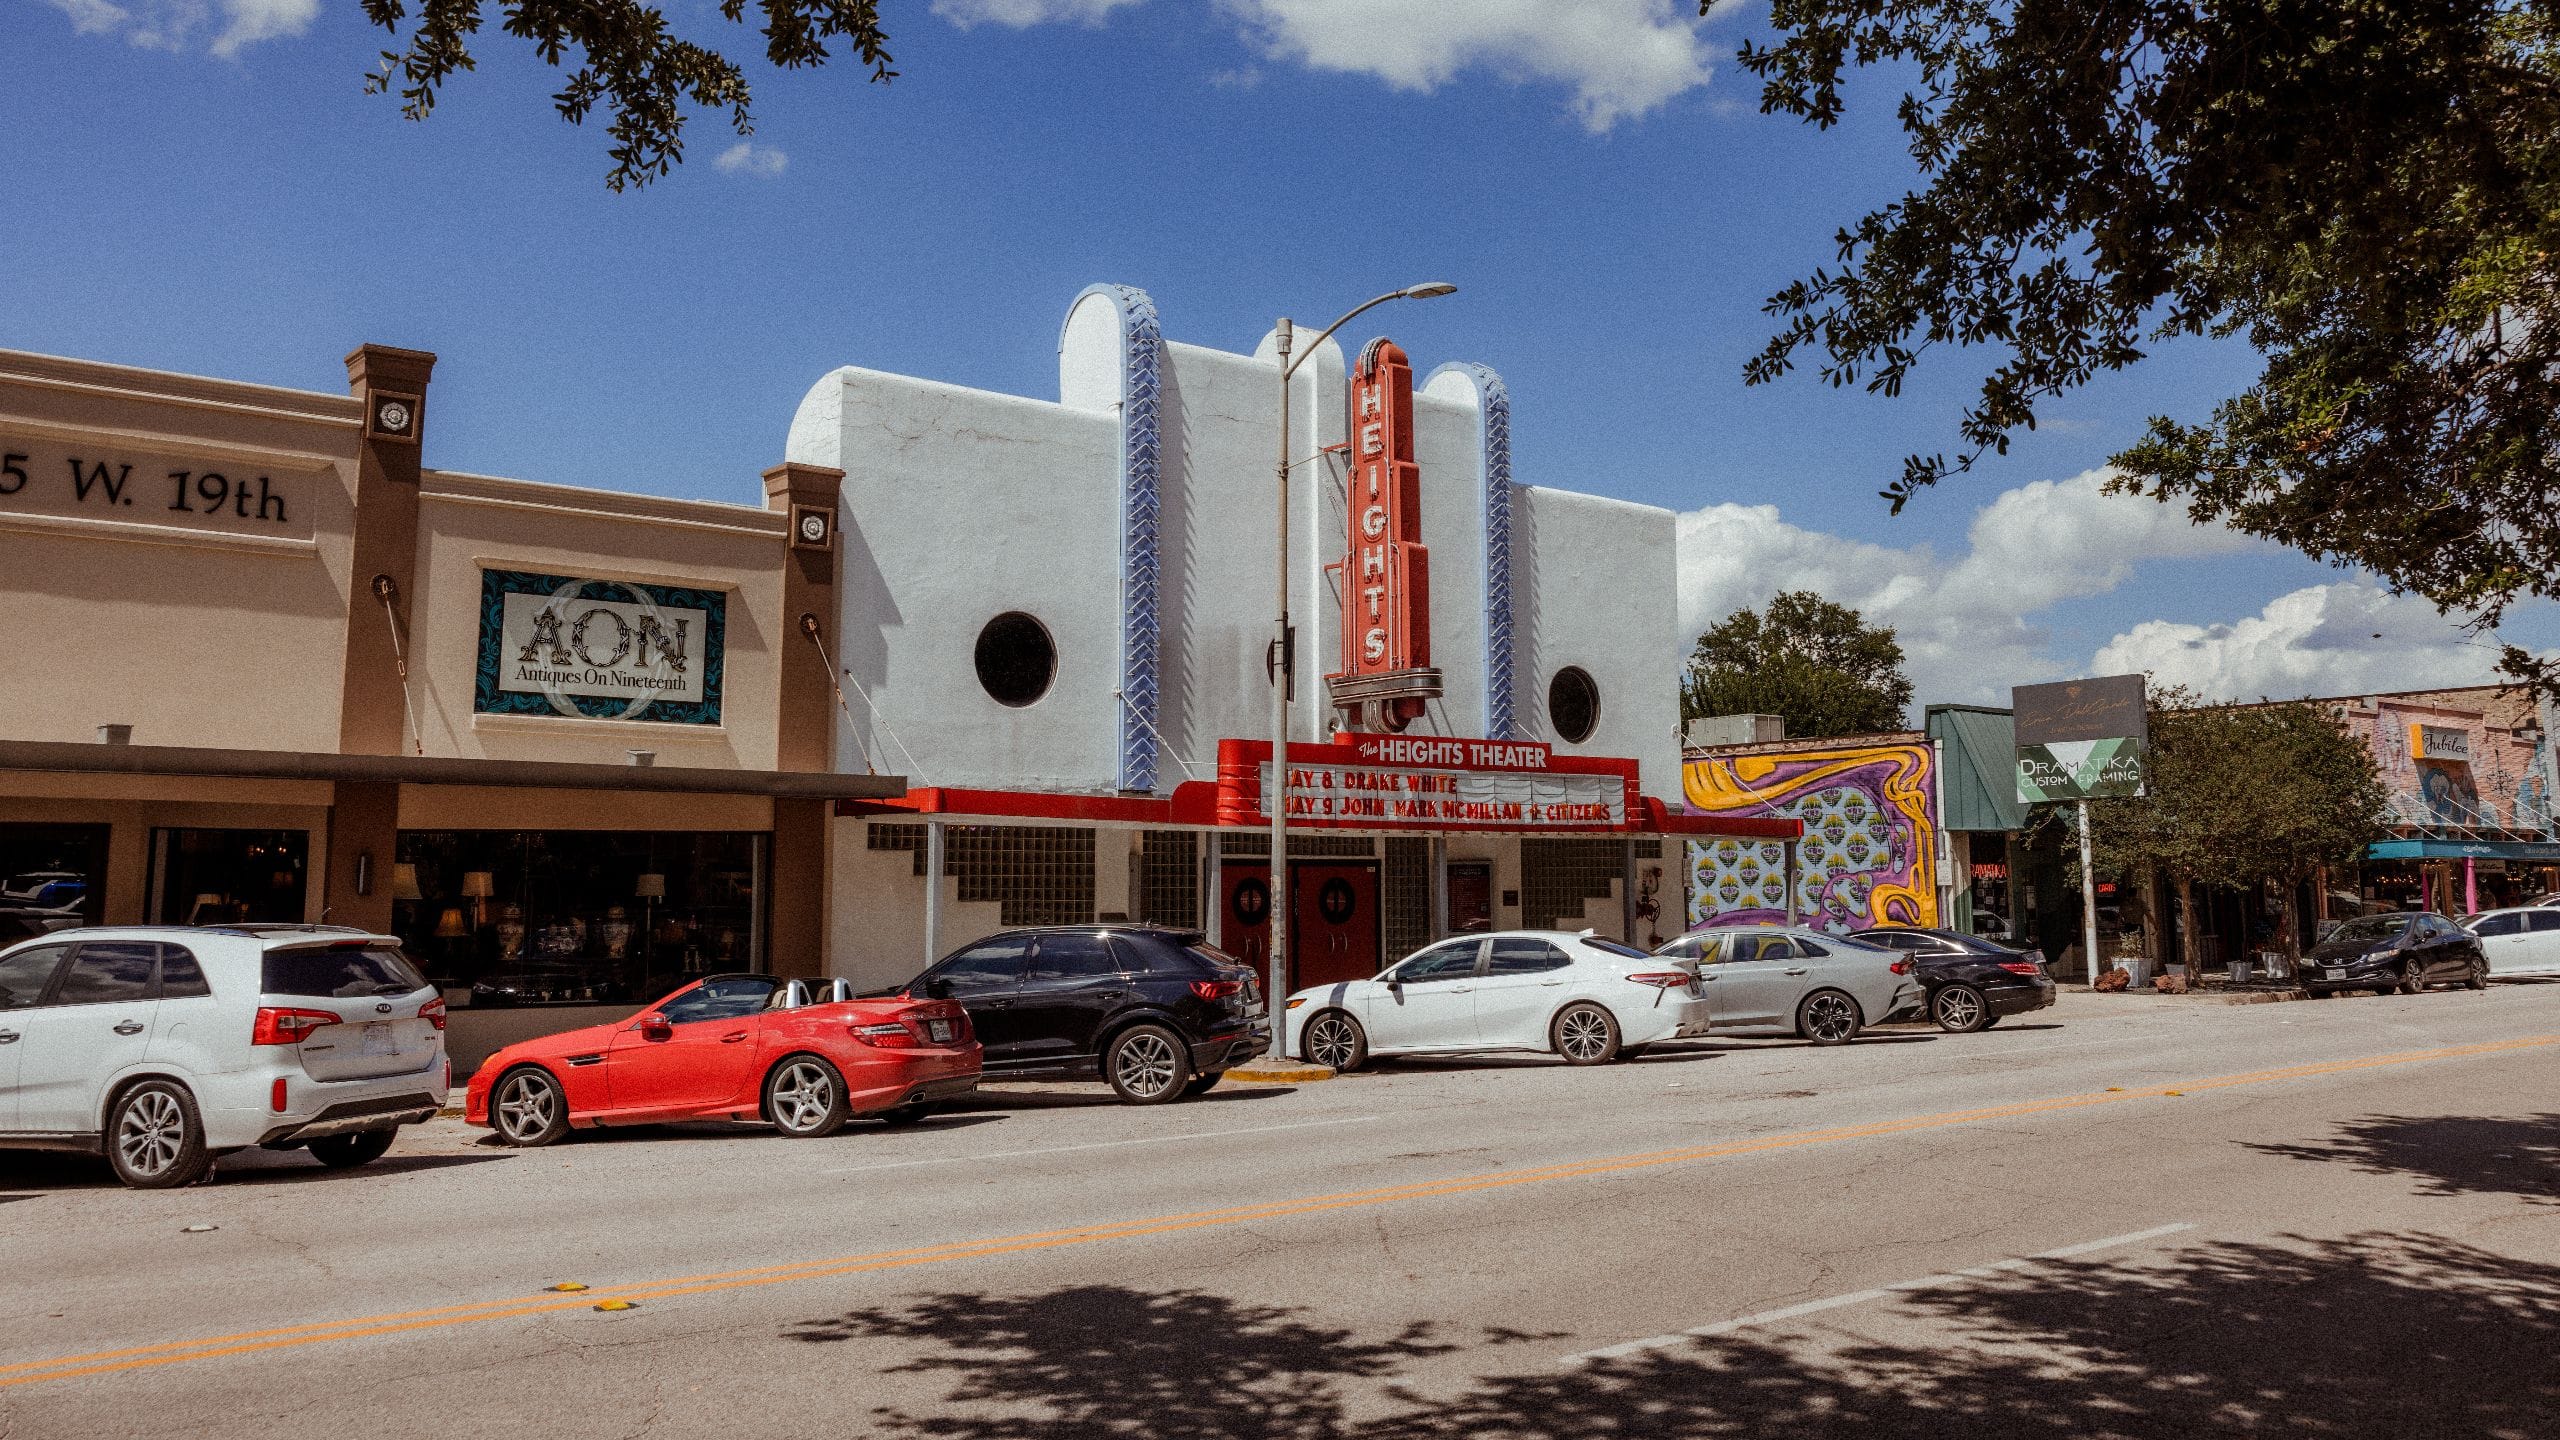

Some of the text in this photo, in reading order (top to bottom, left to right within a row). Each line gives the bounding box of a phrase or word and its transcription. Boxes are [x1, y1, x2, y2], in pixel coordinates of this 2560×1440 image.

[0, 454, 288, 521] 5 W. 19th
[1360, 382, 1387, 664] HEIGHTS
[518, 606, 688, 672] AON
[515, 665, 687, 691] Antiques On Nineteenth
[1358, 739, 1547, 768] The HEIGHTS THEATER
[2422, 734, 2469, 755] Jubilee
[2020, 756, 2139, 776] DRAMATIKA
[1286, 769, 1457, 794] AY 8 DRAKE WHITE
[2021, 771, 2138, 788] CUSTOM FRAMING
[1323, 798, 1333, 815] 9
[1340, 796, 1385, 816] JOHN
[1394, 799, 1438, 818] MARK
[1442, 801, 1522, 820] MCMILLAN
[1546, 803, 1611, 821] CITIZENS
